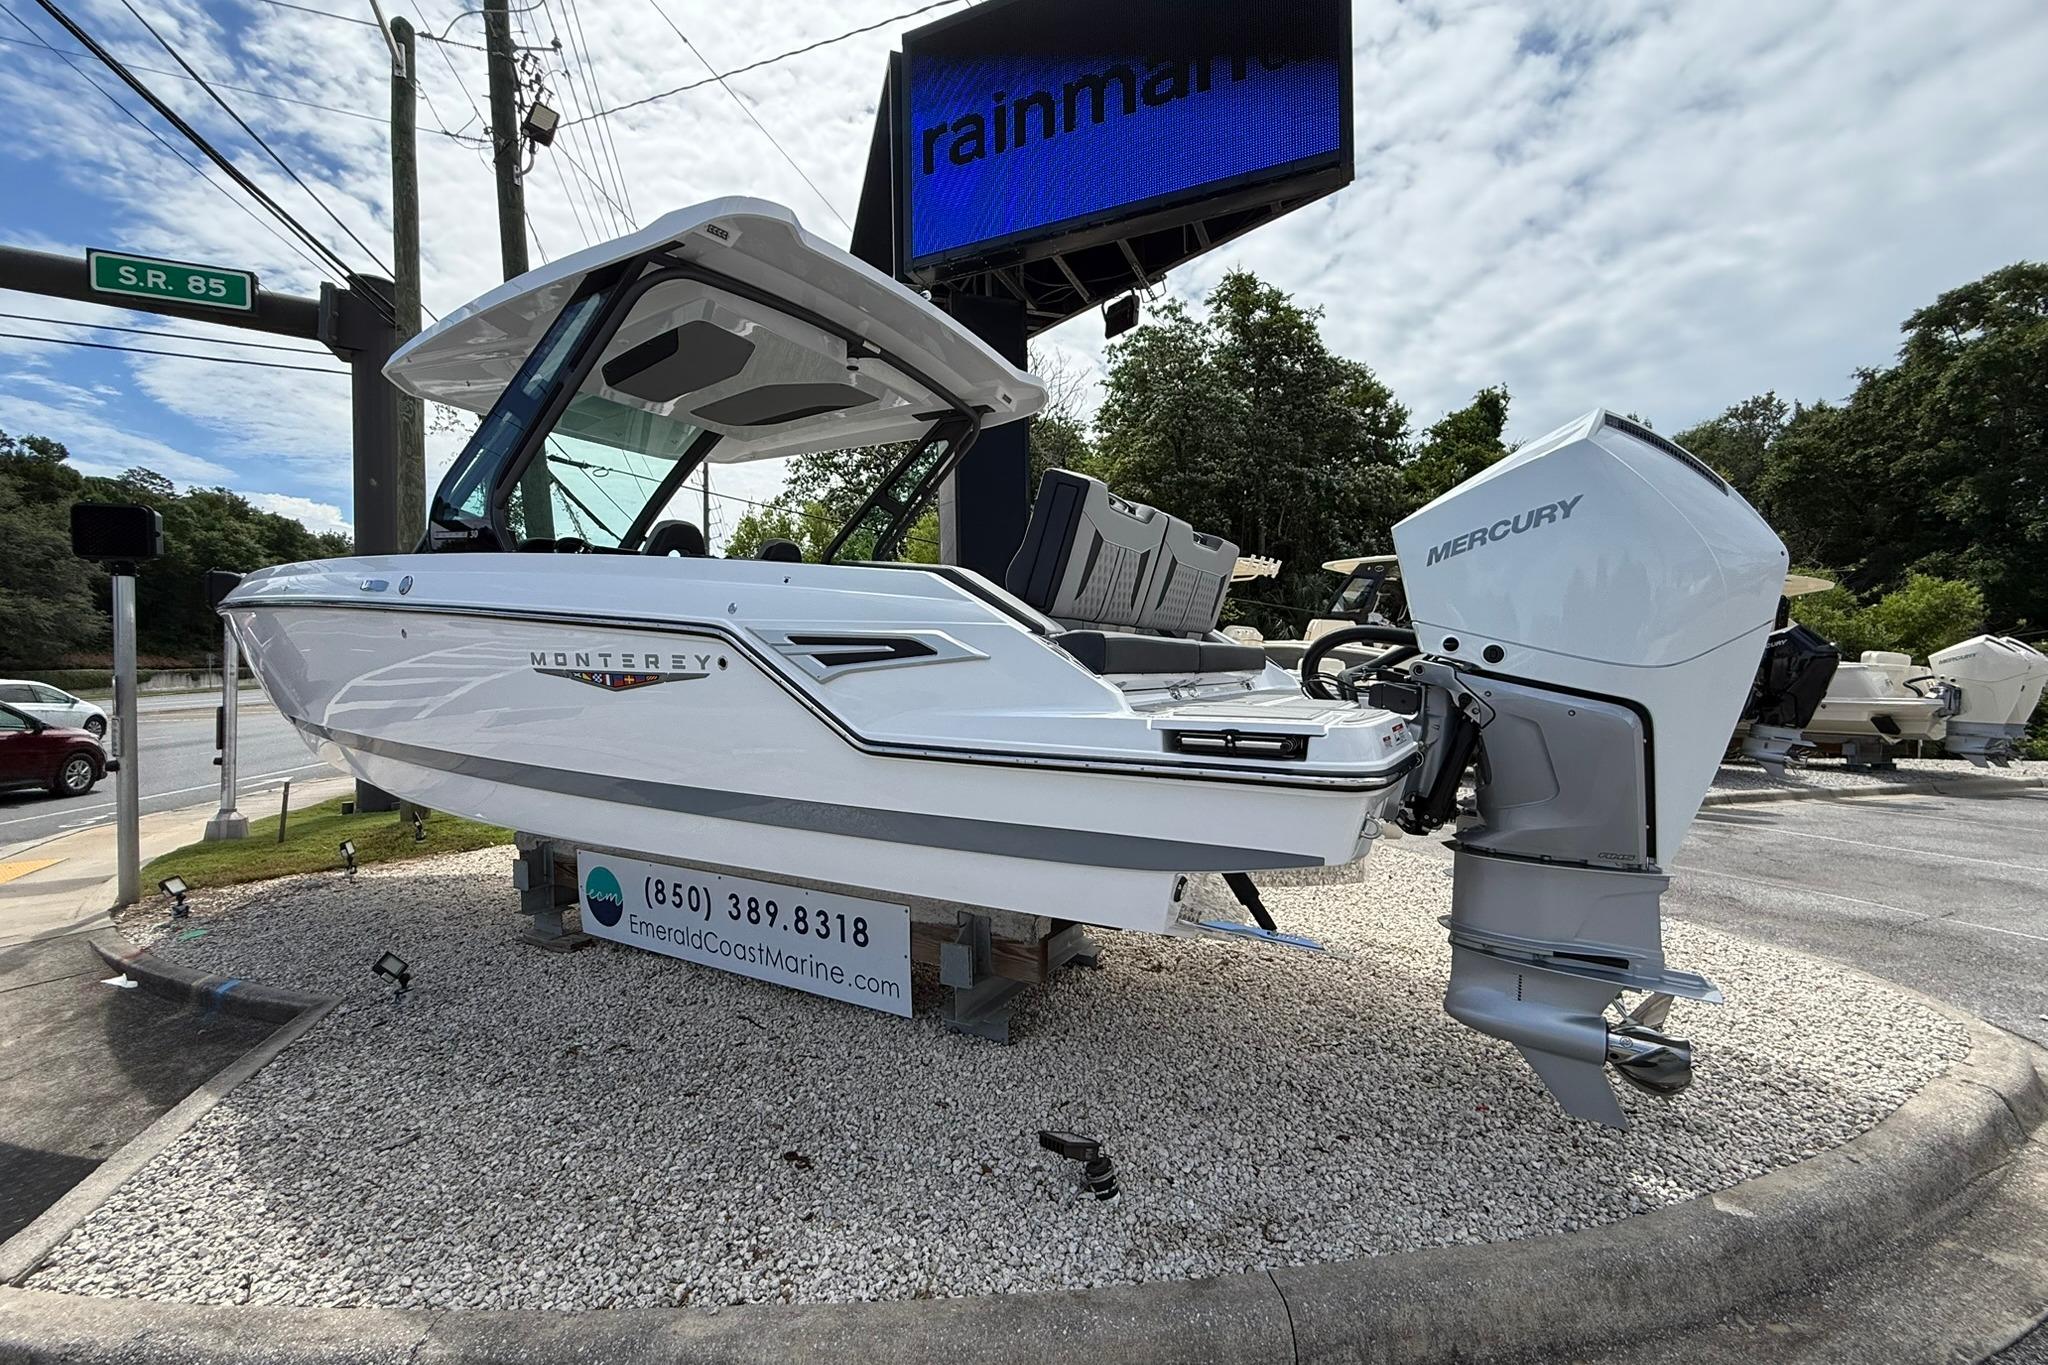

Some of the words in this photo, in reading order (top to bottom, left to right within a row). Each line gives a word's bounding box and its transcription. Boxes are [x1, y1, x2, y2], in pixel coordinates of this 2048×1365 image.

[118, 265, 174, 291] S.R.
[187, 275, 227, 297] 85
[1426, 493, 1585, 568] MERCURY
[530, 652, 711, 670] MONTEREY
[644, 876, 712, 921] (850)
[728, 893, 869, 948] 389.8318
[629, 913, 900, 999] EmeraldCoastMarine.com
